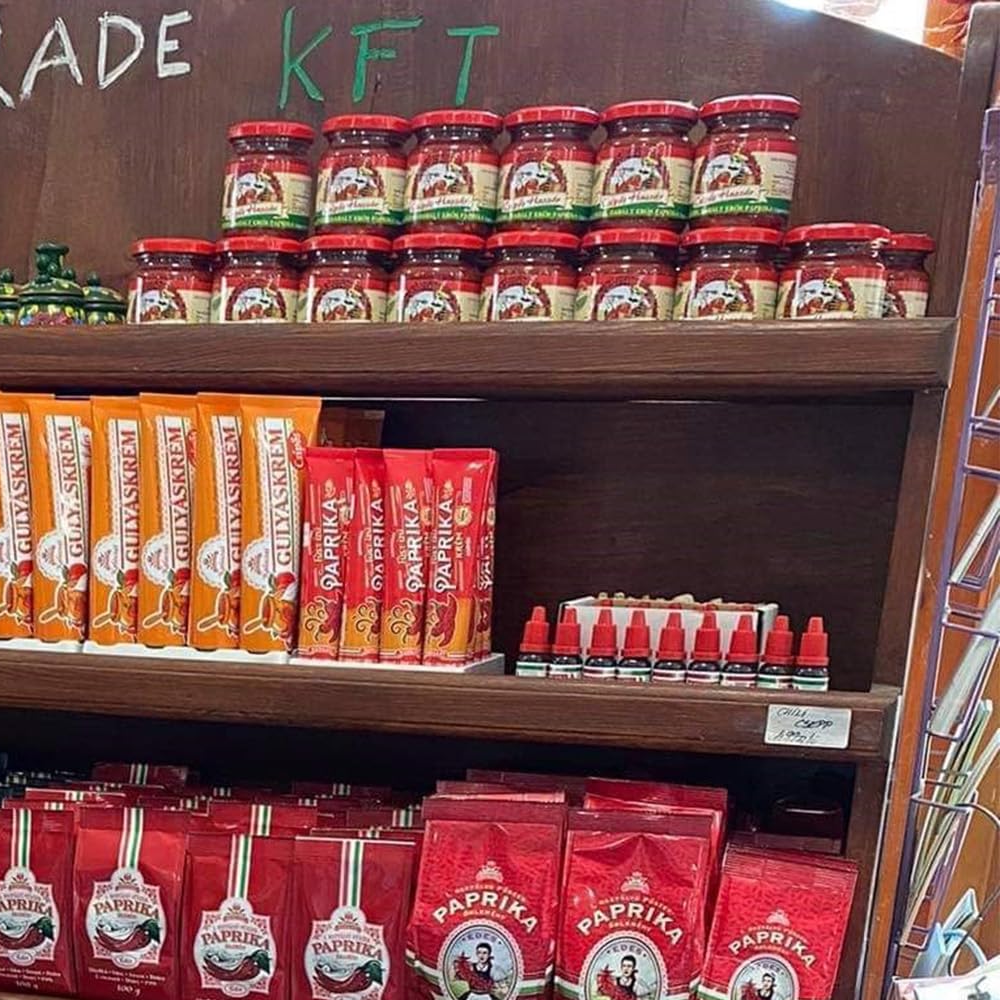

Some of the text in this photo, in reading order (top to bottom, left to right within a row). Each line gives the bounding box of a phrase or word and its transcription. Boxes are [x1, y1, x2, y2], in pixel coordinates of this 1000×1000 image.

[280, 6, 501, 112] KFT
[320, 498, 343, 590] PAPRIKA
[371, 499, 385, 591] PAPRIKA
[403, 500, 426, 592] PAPRIKA
[433, 500, 456, 593] PAPRIKA
[93, 898, 160, 918] PAPRIKA
[432, 890, 538, 934] PAPRIKA
[576, 902, 684, 946] PAPRIKA
[201, 929, 271, 951] PAPRIKA
[312, 938, 384, 961] PAPRIKA
[728, 930, 817, 969] PAPRIKA
